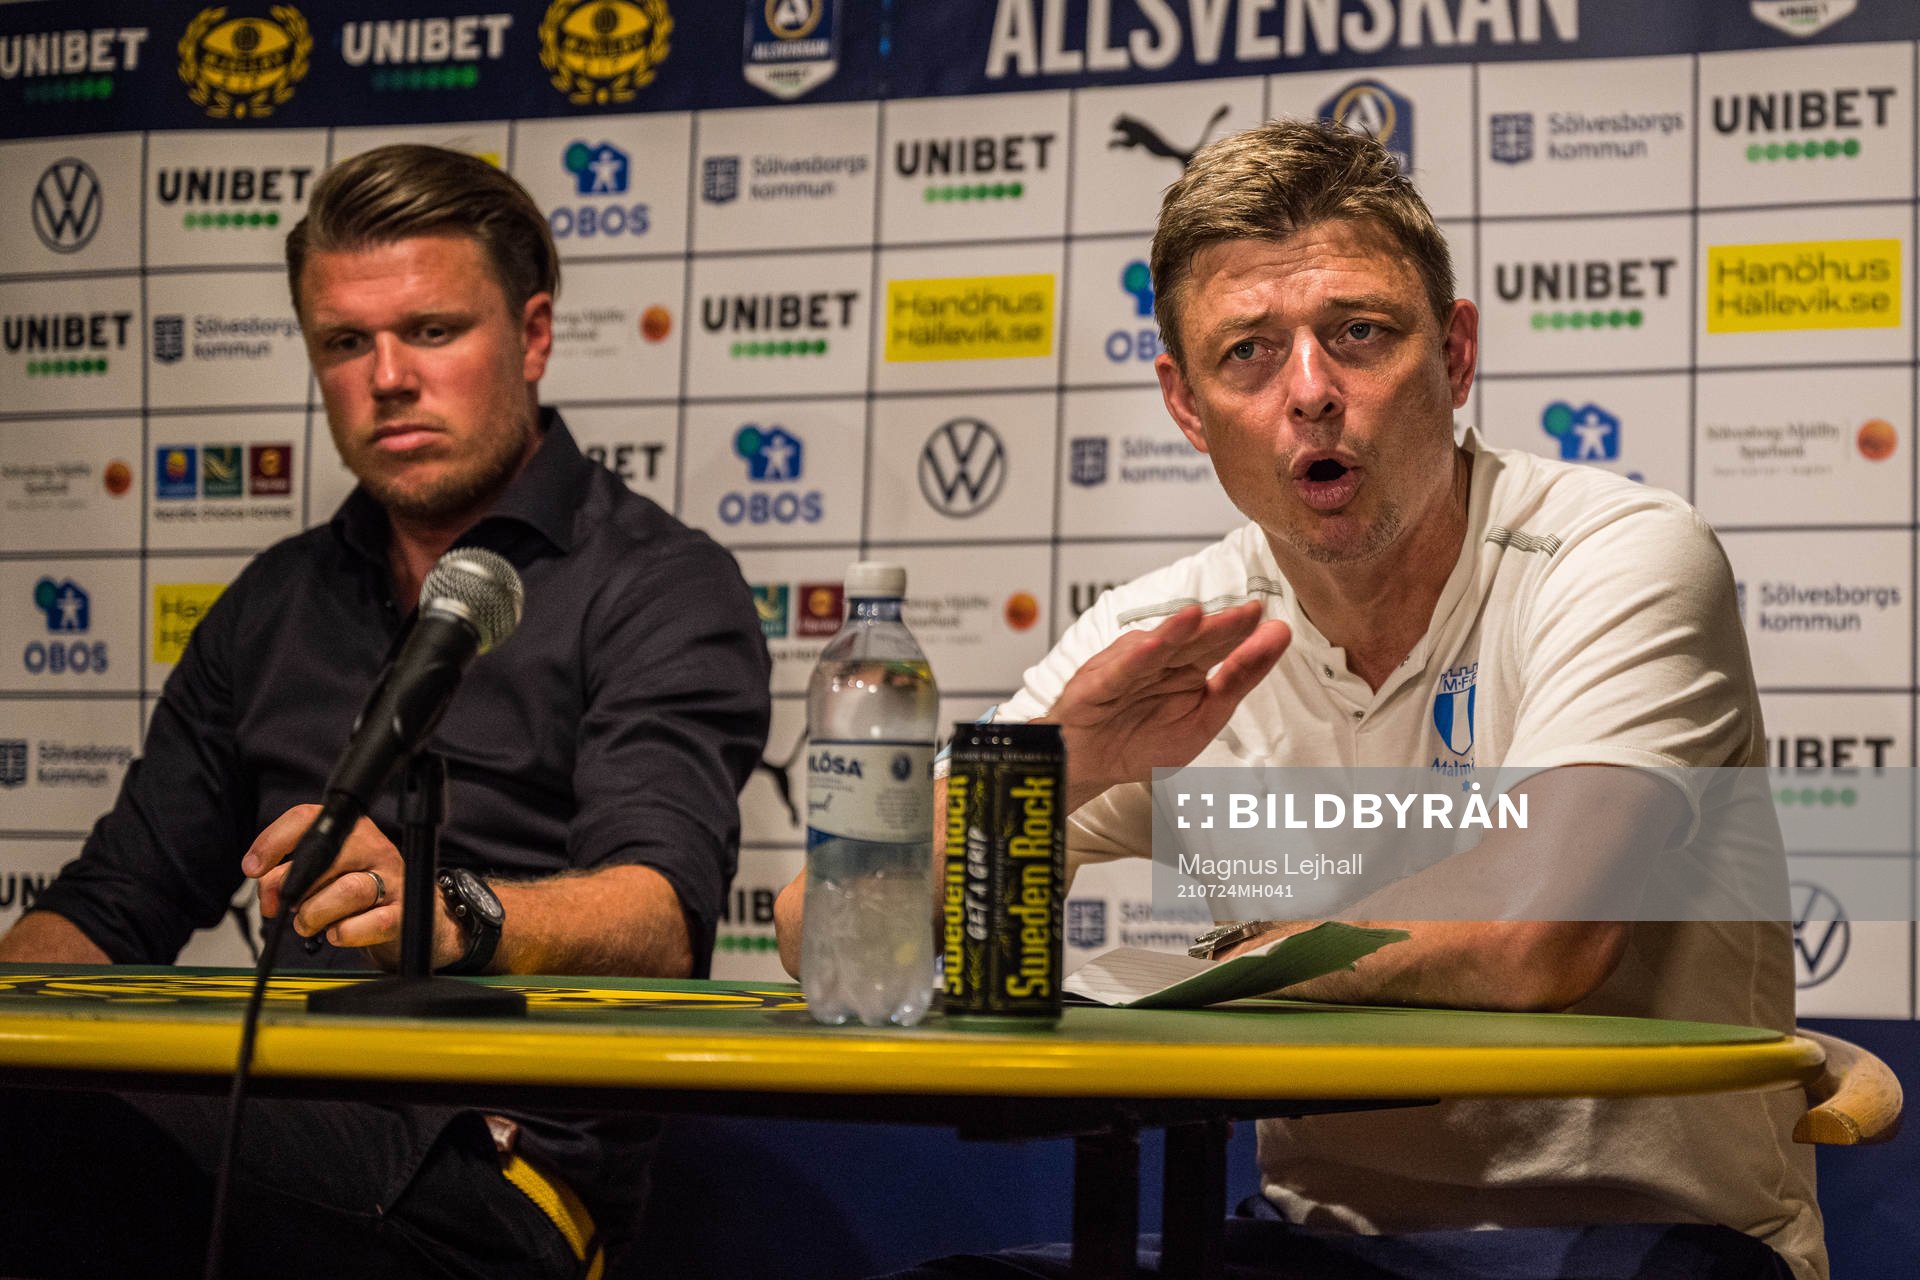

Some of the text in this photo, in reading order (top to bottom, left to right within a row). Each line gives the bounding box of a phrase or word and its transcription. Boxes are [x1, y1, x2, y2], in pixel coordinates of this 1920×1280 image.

[0, 27, 148, 80] UNIBET
[342, 14, 512, 66] UNIBET
[1548, 112, 1684, 138] Sölvesborgs
[1713, 88, 1895, 133] UNIBET
[895, 133, 1056, 177] UNIBET
[1548, 138, 1648, 161] kommun
[157, 167, 312, 206] UNIBET
[550, 204, 649, 237] OBOS
[1496, 258, 1677, 302] UNIBET
[702, 291, 857, 332] UNIBET
[3, 311, 131, 352] UNIBET
[1106, 330, 1166, 363] OB
[1122, 437, 1196, 458] Sölves
[719, 491, 823, 525] OBOS
[1759, 582, 1901, 610] Sölvesborgs
[1759, 610, 1861, 632] kommun
[24, 642, 107, 674] OBOS
[809, 752, 863, 779] LÖSA
[1766, 736, 1894, 777] IBET
[1006, 775, 1054, 998] Sweden Rock
